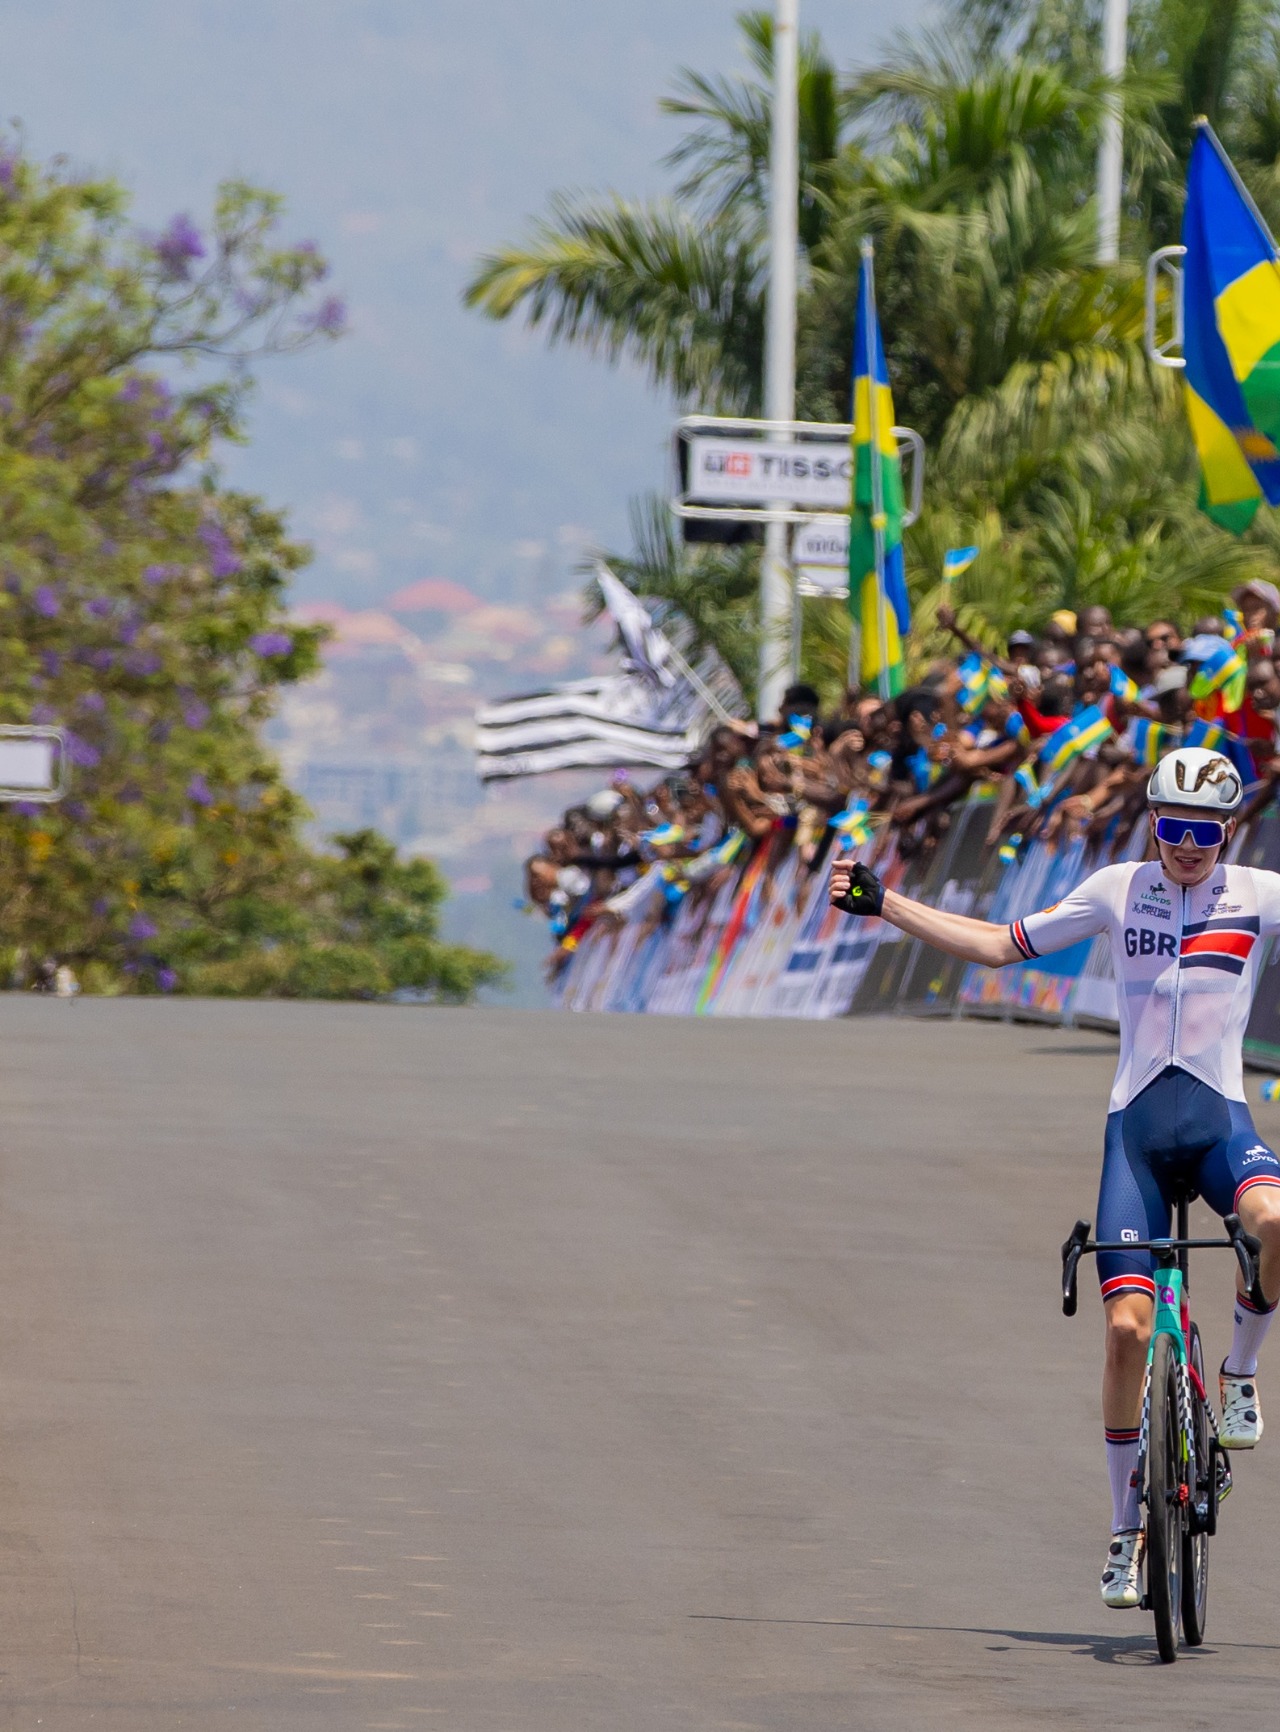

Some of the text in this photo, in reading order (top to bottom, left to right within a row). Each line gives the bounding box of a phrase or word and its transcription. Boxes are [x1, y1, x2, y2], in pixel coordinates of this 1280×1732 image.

[759, 454, 853, 479] TISSO
[1140, 892, 1172, 906] LLOYDS
[1124, 928, 1177, 957] GBR
[1242, 1155, 1279, 1165] LLOYDS
